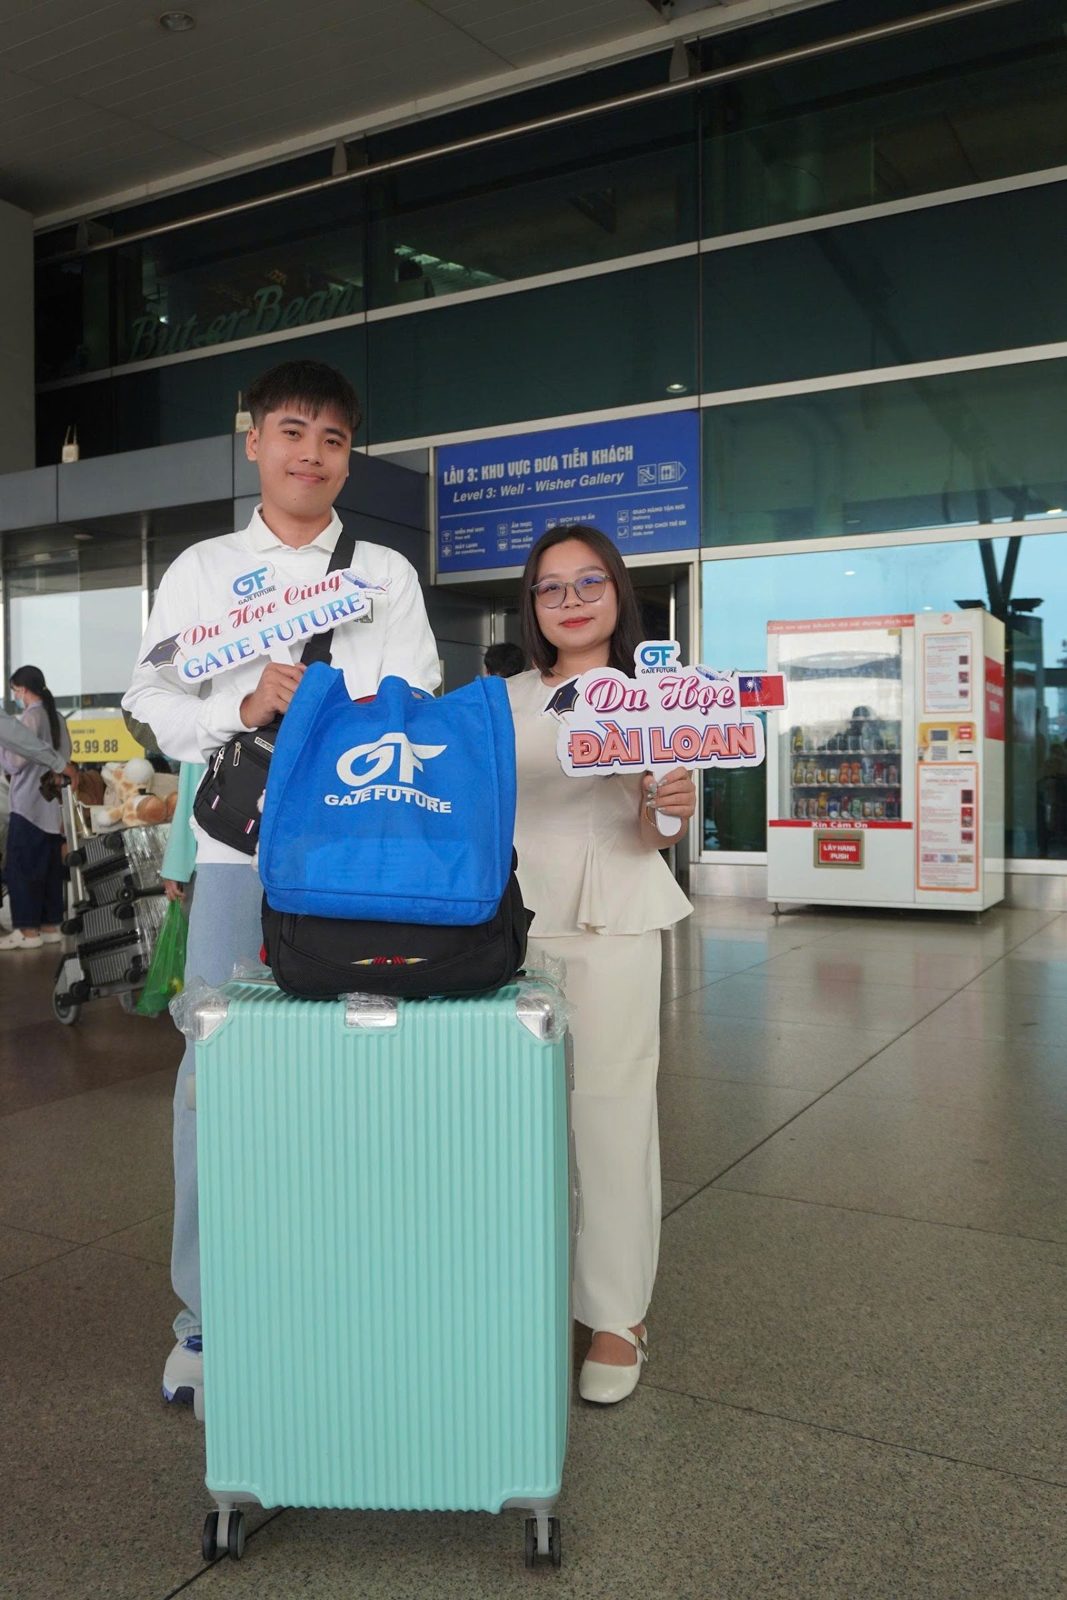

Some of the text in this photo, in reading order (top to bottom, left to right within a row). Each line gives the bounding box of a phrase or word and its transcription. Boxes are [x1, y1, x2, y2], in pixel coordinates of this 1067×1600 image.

[443, 444, 634, 485] LẦU 3: KHU VỰC ĐƯA TIỄN KHÁCH
[453, 488, 483, 503] Level
[486, 487, 497, 499] 3:
[500, 483, 524, 497] Well
[535, 478, 576, 492] Wisher
[579, 472, 624, 487] Gallery
[233, 567, 268, 597] GF
[238, 585, 276, 605] GATE FUTURE
[183, 571, 342, 645] Du Học Cùng
[184, 592, 365, 678] GATE FUTURE
[641, 646, 675, 666] GF
[585, 675, 736, 715] Du Học
[568, 720, 757, 768] ĐÀI LOAN
[324, 785, 452, 813] GATE FUTURE
